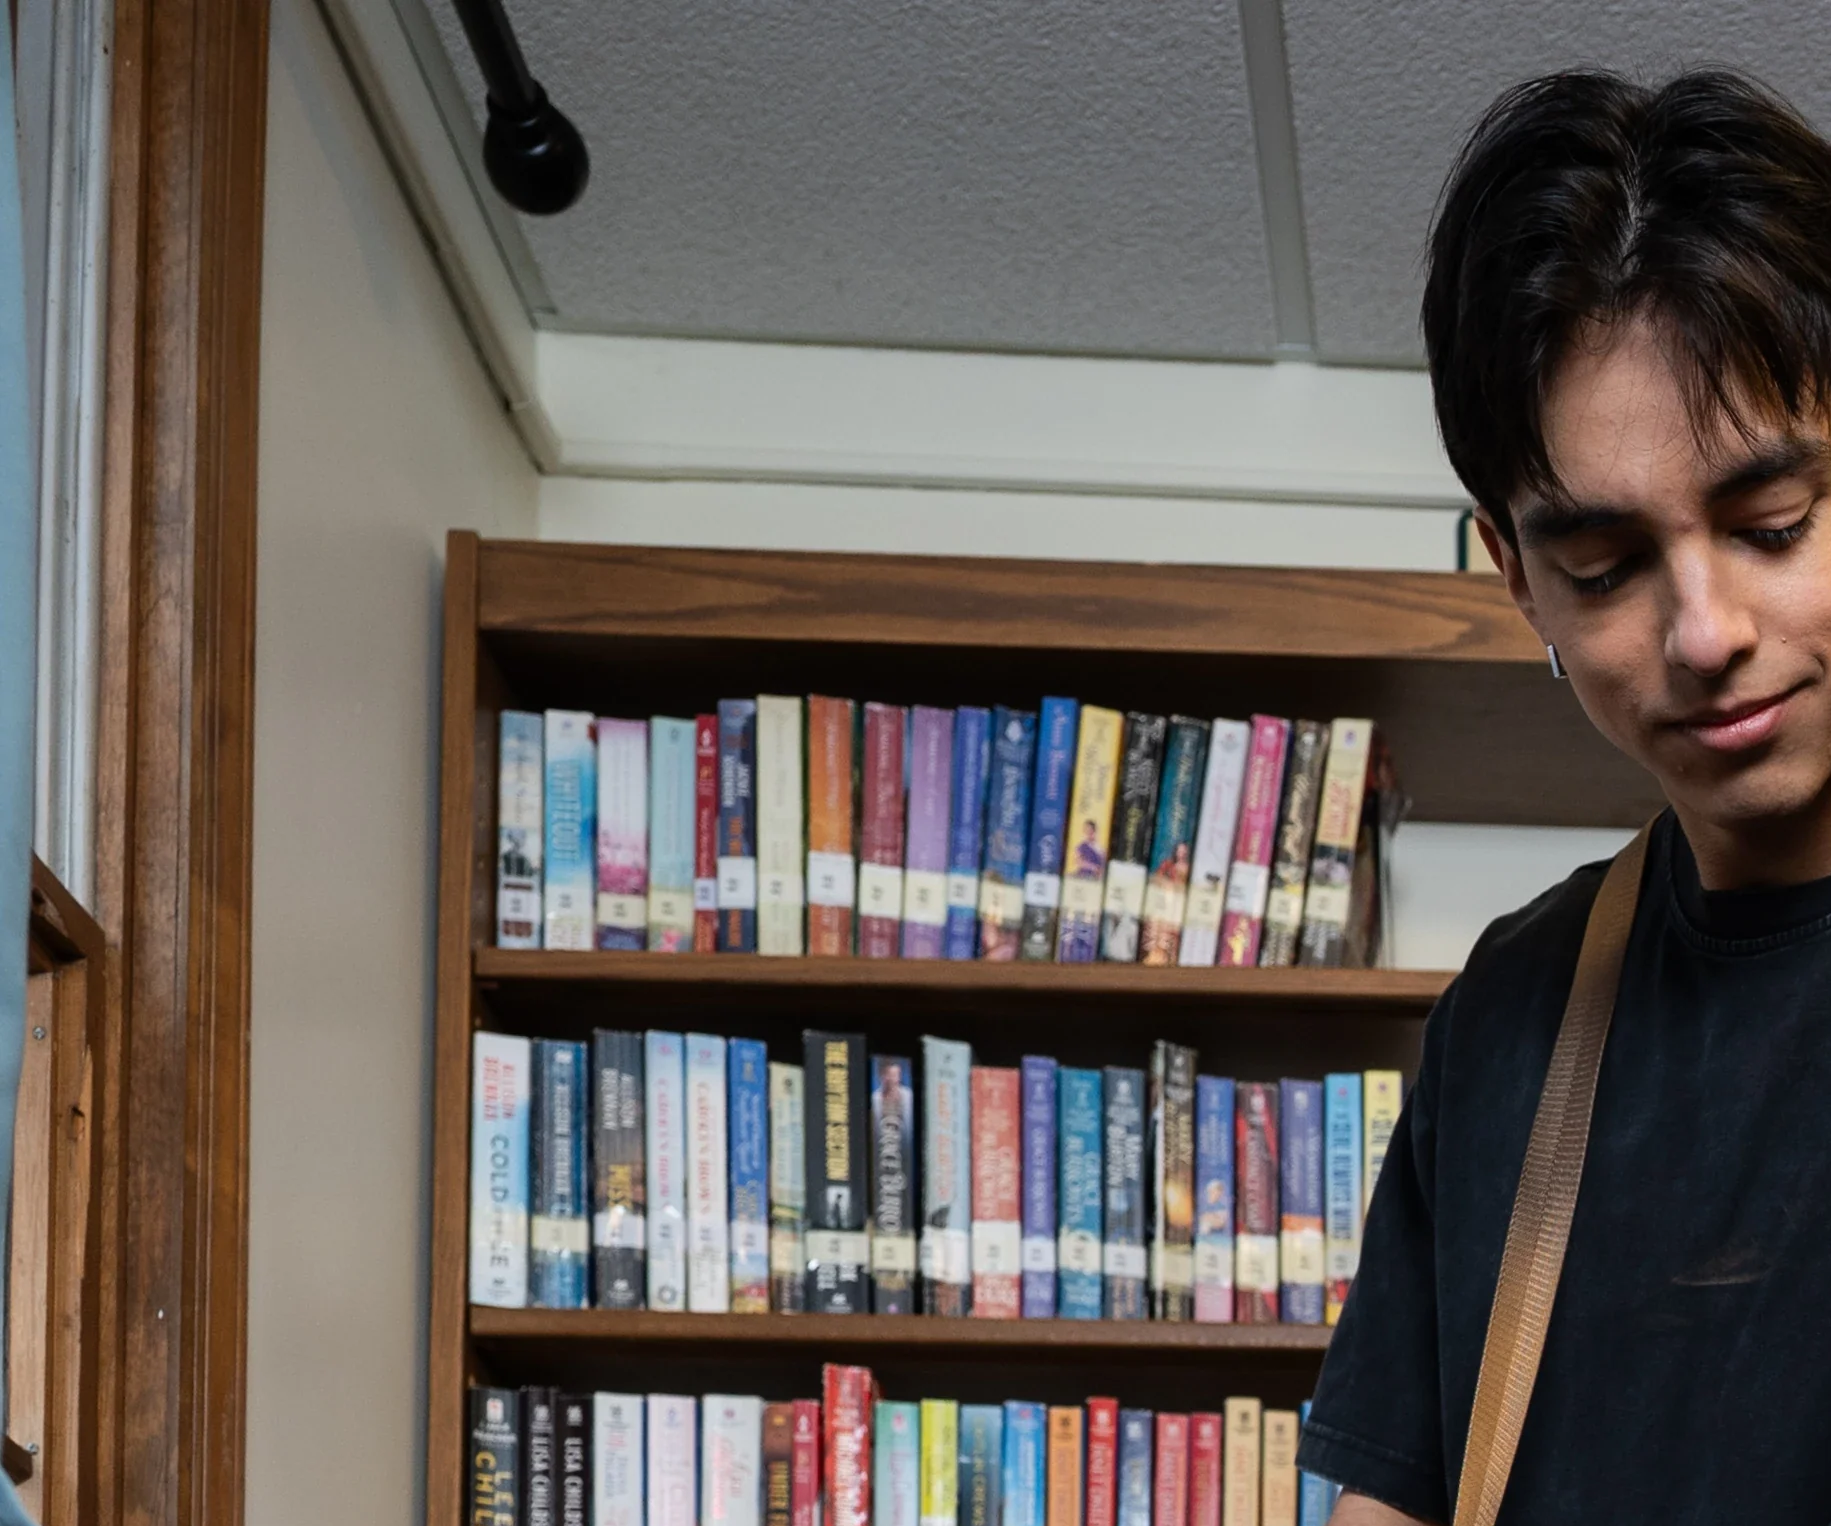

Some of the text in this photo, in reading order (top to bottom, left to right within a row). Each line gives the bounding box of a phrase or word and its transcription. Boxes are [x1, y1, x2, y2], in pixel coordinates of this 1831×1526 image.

[491, 1133, 511, 1204] COLD
[877, 1172, 906, 1232] BURRO
[563, 1437, 584, 1472] LISA
